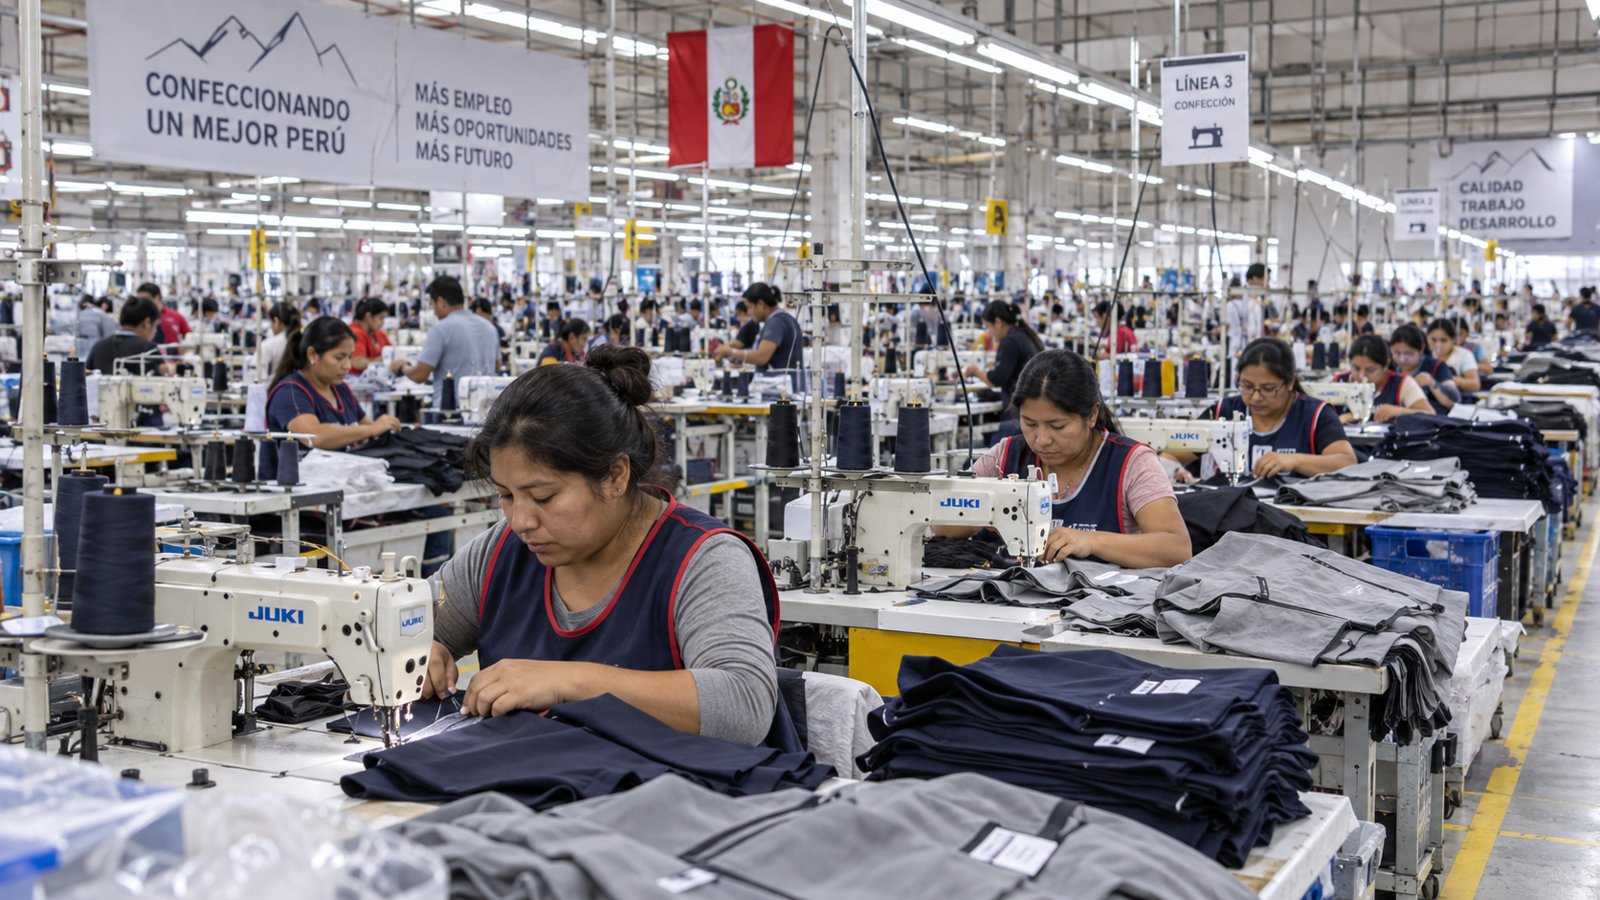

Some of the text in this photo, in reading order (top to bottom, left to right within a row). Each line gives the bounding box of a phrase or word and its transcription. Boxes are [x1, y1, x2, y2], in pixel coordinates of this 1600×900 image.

[1176, 74, 1233, 92] LÍNEA 3
[145, 71, 350, 122] CONFECCIONANDO
[415, 80, 512, 116] MÁS EMPLEO
[1174, 96, 1236, 111] CONFECCIÓN
[147, 108, 345, 155] UN MEJOR PERÚ
[415, 110, 572, 151] MÁS OPORTUNIDADES
[416, 138, 513, 170] MÁS FUTURO
[1459, 180, 1524, 194] CALIDAD
[1460, 198, 1525, 213] TRABAJO
[1459, 215, 1556, 231] DESARROLLO
[1170, 432, 1199, 440] JUKI
[940, 498, 980, 508] JUKI
[248, 605, 304, 625] JUKI
